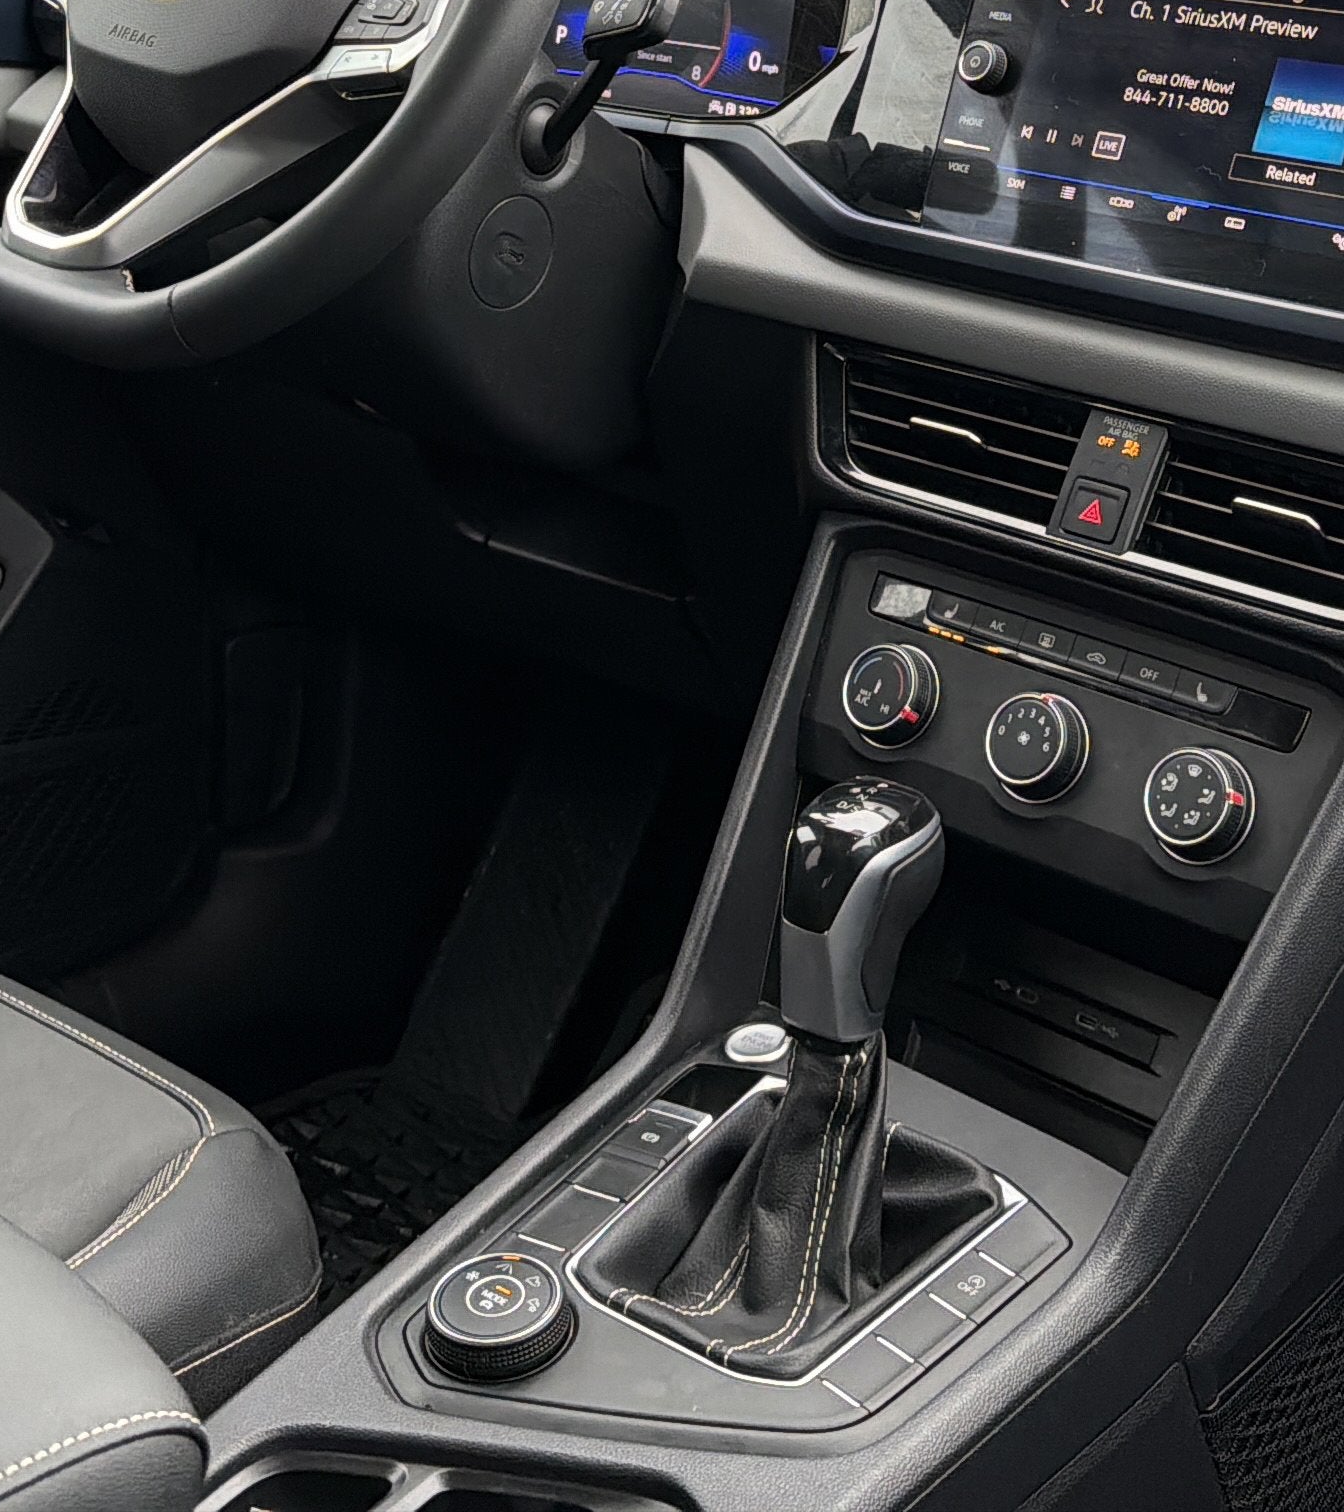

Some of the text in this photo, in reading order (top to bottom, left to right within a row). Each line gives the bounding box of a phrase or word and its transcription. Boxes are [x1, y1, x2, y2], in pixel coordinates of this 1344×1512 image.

[988, 10, 1013, 22] MEDIA
[1130, 0, 1319, 40] Ch. 1 SiriusXM Preview
[109, 23, 157, 48] AIRBAG
[556, 24, 568, 45] P
[637, 49, 673, 64] Since start
[748, 50, 762, 72] 0
[691, 64, 702, 81] 8
[1136, 68, 1236, 96] Great Offer Now!
[1123, 86, 1230, 117] 844-711-8800
[958, 114, 985, 128] PHONE
[1098, 140, 1119, 153] LIVE
[948, 161, 971, 174] VOICE
[1265, 164, 1317, 187] Related
[1006, 177, 1026, 190] SXM
[1103, 415, 1151, 435] PASSENGER
[1097, 435, 1116, 448] OFF
[989, 619, 1006, 633] A/C
[1139, 667, 1160, 682] OFF
[854, 693, 871, 707] A/C
[1007, 713, 1013, 724] 1
[1017, 708, 1025, 718] 2
[1029, 708, 1036, 719] 3
[1038, 715, 1046, 726] 4
[998, 725, 1006, 735] 0
[1043, 726, 1051, 738] 5
[1042, 742, 1051, 752] 6
[957, 1281, 979, 1296] OFF
[480, 1289, 509, 1306] MODE
